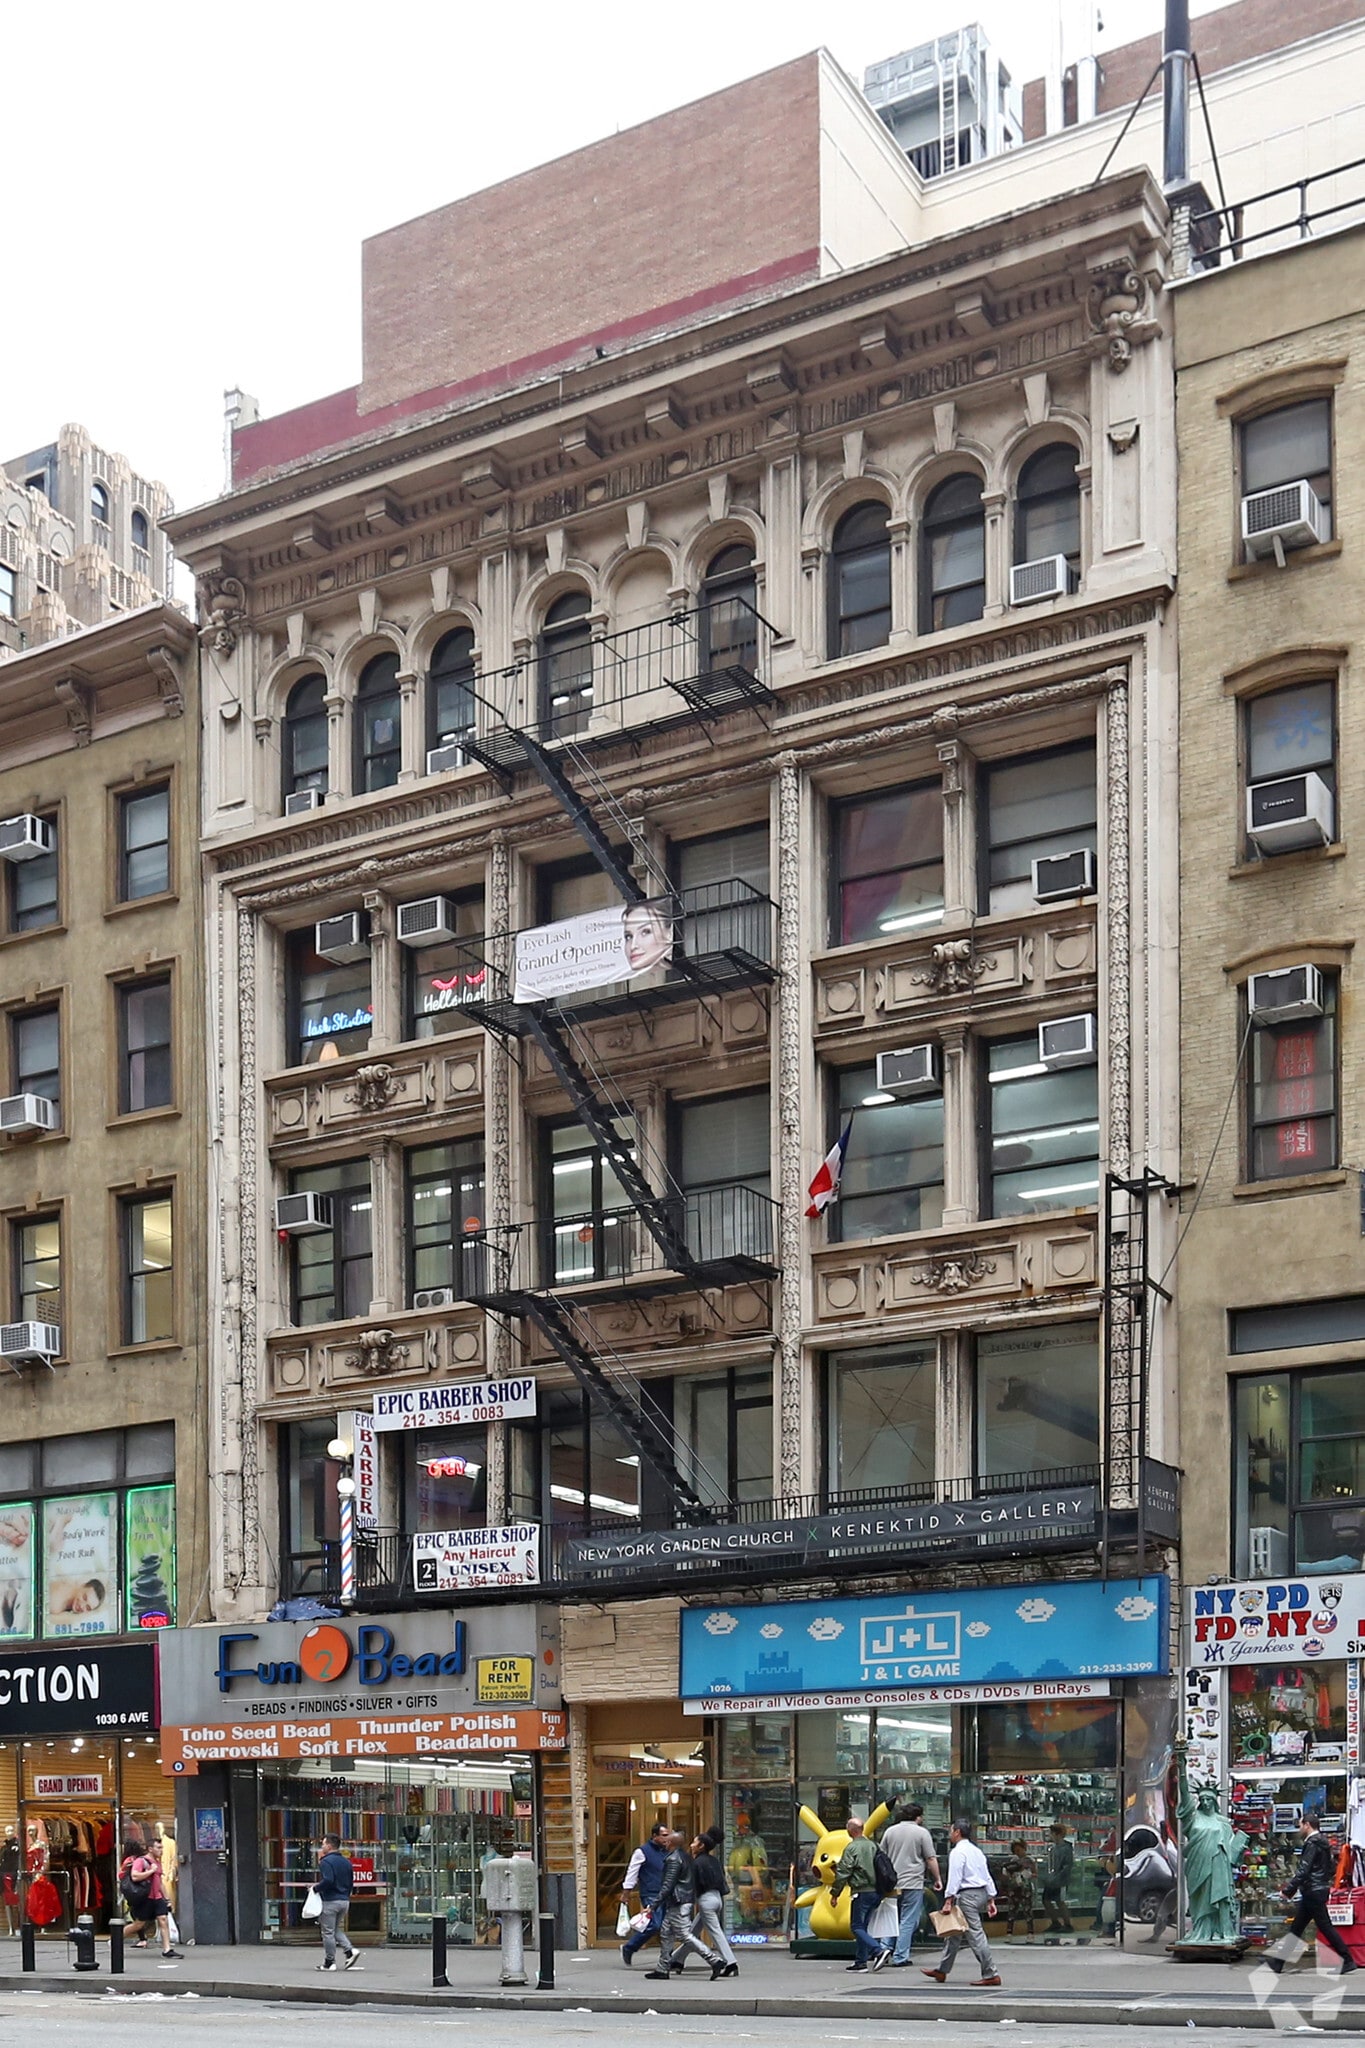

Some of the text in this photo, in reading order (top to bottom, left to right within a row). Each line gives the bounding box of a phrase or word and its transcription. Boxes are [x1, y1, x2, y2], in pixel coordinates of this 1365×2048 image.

[517, 937, 622, 972] Grand Opening
[332, 1008, 372, 1031] Studio
[378, 1380, 533, 1415] EPIC BARBER SHOP
[355, 1413, 374, 1428] EPIC
[403, 1413, 425, 1427] 212
[438, 1410, 460, 1424] 354
[472, 1405, 504, 1420] 0083
[360, 1428, 374, 1515] BARBER
[356, 1515, 377, 1528] SHOP
[416, 1526, 537, 1549] EPIC BARBER SHOP
[578, 1547, 612, 1561] NEW
[616, 1543, 655, 1557] YORK
[661, 1537, 721, 1554] GARDEN
[728, 1530, 793, 1548] CHURCH
[831, 1515, 940, 1538] KENEKTID
[955, 1513, 965, 1526] X
[981, 1500, 1082, 1523] GALLERY
[442, 1545, 516, 1563] Any Haircut
[450, 1562, 510, 1576] UNISEX
[439, 1577, 459, 1589] 212
[468, 1574, 487, 1586] 354
[497, 1573, 523, 1585] 0083
[1195, 1583, 1310, 1615] NY PD
[1320, 1587, 1342, 1598] NETS
[140, 1616, 169, 1628] OPEN
[1195, 1611, 1311, 1642] FD NY
[541, 1625, 556, 1641] Fun
[353, 1620, 467, 1686] Bead
[1229, 1639, 1295, 1662] Yankees
[1347, 1639, 1365, 1654] Six
[214, 1633, 301, 1693] Fun
[314, 1649, 334, 1678] 2
[492, 1660, 516, 1671] FOR
[861, 1662, 960, 1681] J & L GAME
[1079, 1662, 1153, 1674] 212-233-3399
[488, 1672, 520, 1683] RENT
[541, 1673, 558, 1688] Bead
[480, 1690, 529, 1700] 212-302-3000
[710, 1684, 731, 1693] 1026
[252, 1695, 438, 1716] BEADS FINDINGS SILVER GIFTS
[701, 1701, 720, 1712] We
[723, 1698, 763, 1713] Repair
[766, 1697, 781, 1708] all
[783, 1695, 820, 1707] Video
[824, 1694, 861, 1706] Game
[865, 1690, 926, 1703] Consoles
[929, 1689, 939, 1700] &
[943, 1688, 971, 1699] CDs
[983, 1686, 1021, 1698] DVDs
[1033, 1683, 1091, 1695] BluRays
[95, 1712, 149, 1725] 1030 6 AVE
[357, 1714, 516, 1735] Thunder Polish
[541, 1711, 561, 1724] Fun
[179, 1722, 331, 1742] Toho Seed Bead
[548, 1725, 555, 1736] 2
[182, 1738, 388, 1759] Swarovski Soft Flex
[416, 1735, 518, 1751] Beadalon
[540, 1736, 565, 1748] Bead
[638, 1760, 660, 1769] 6th
[38, 1777, 99, 1794] GRAND OPENING
